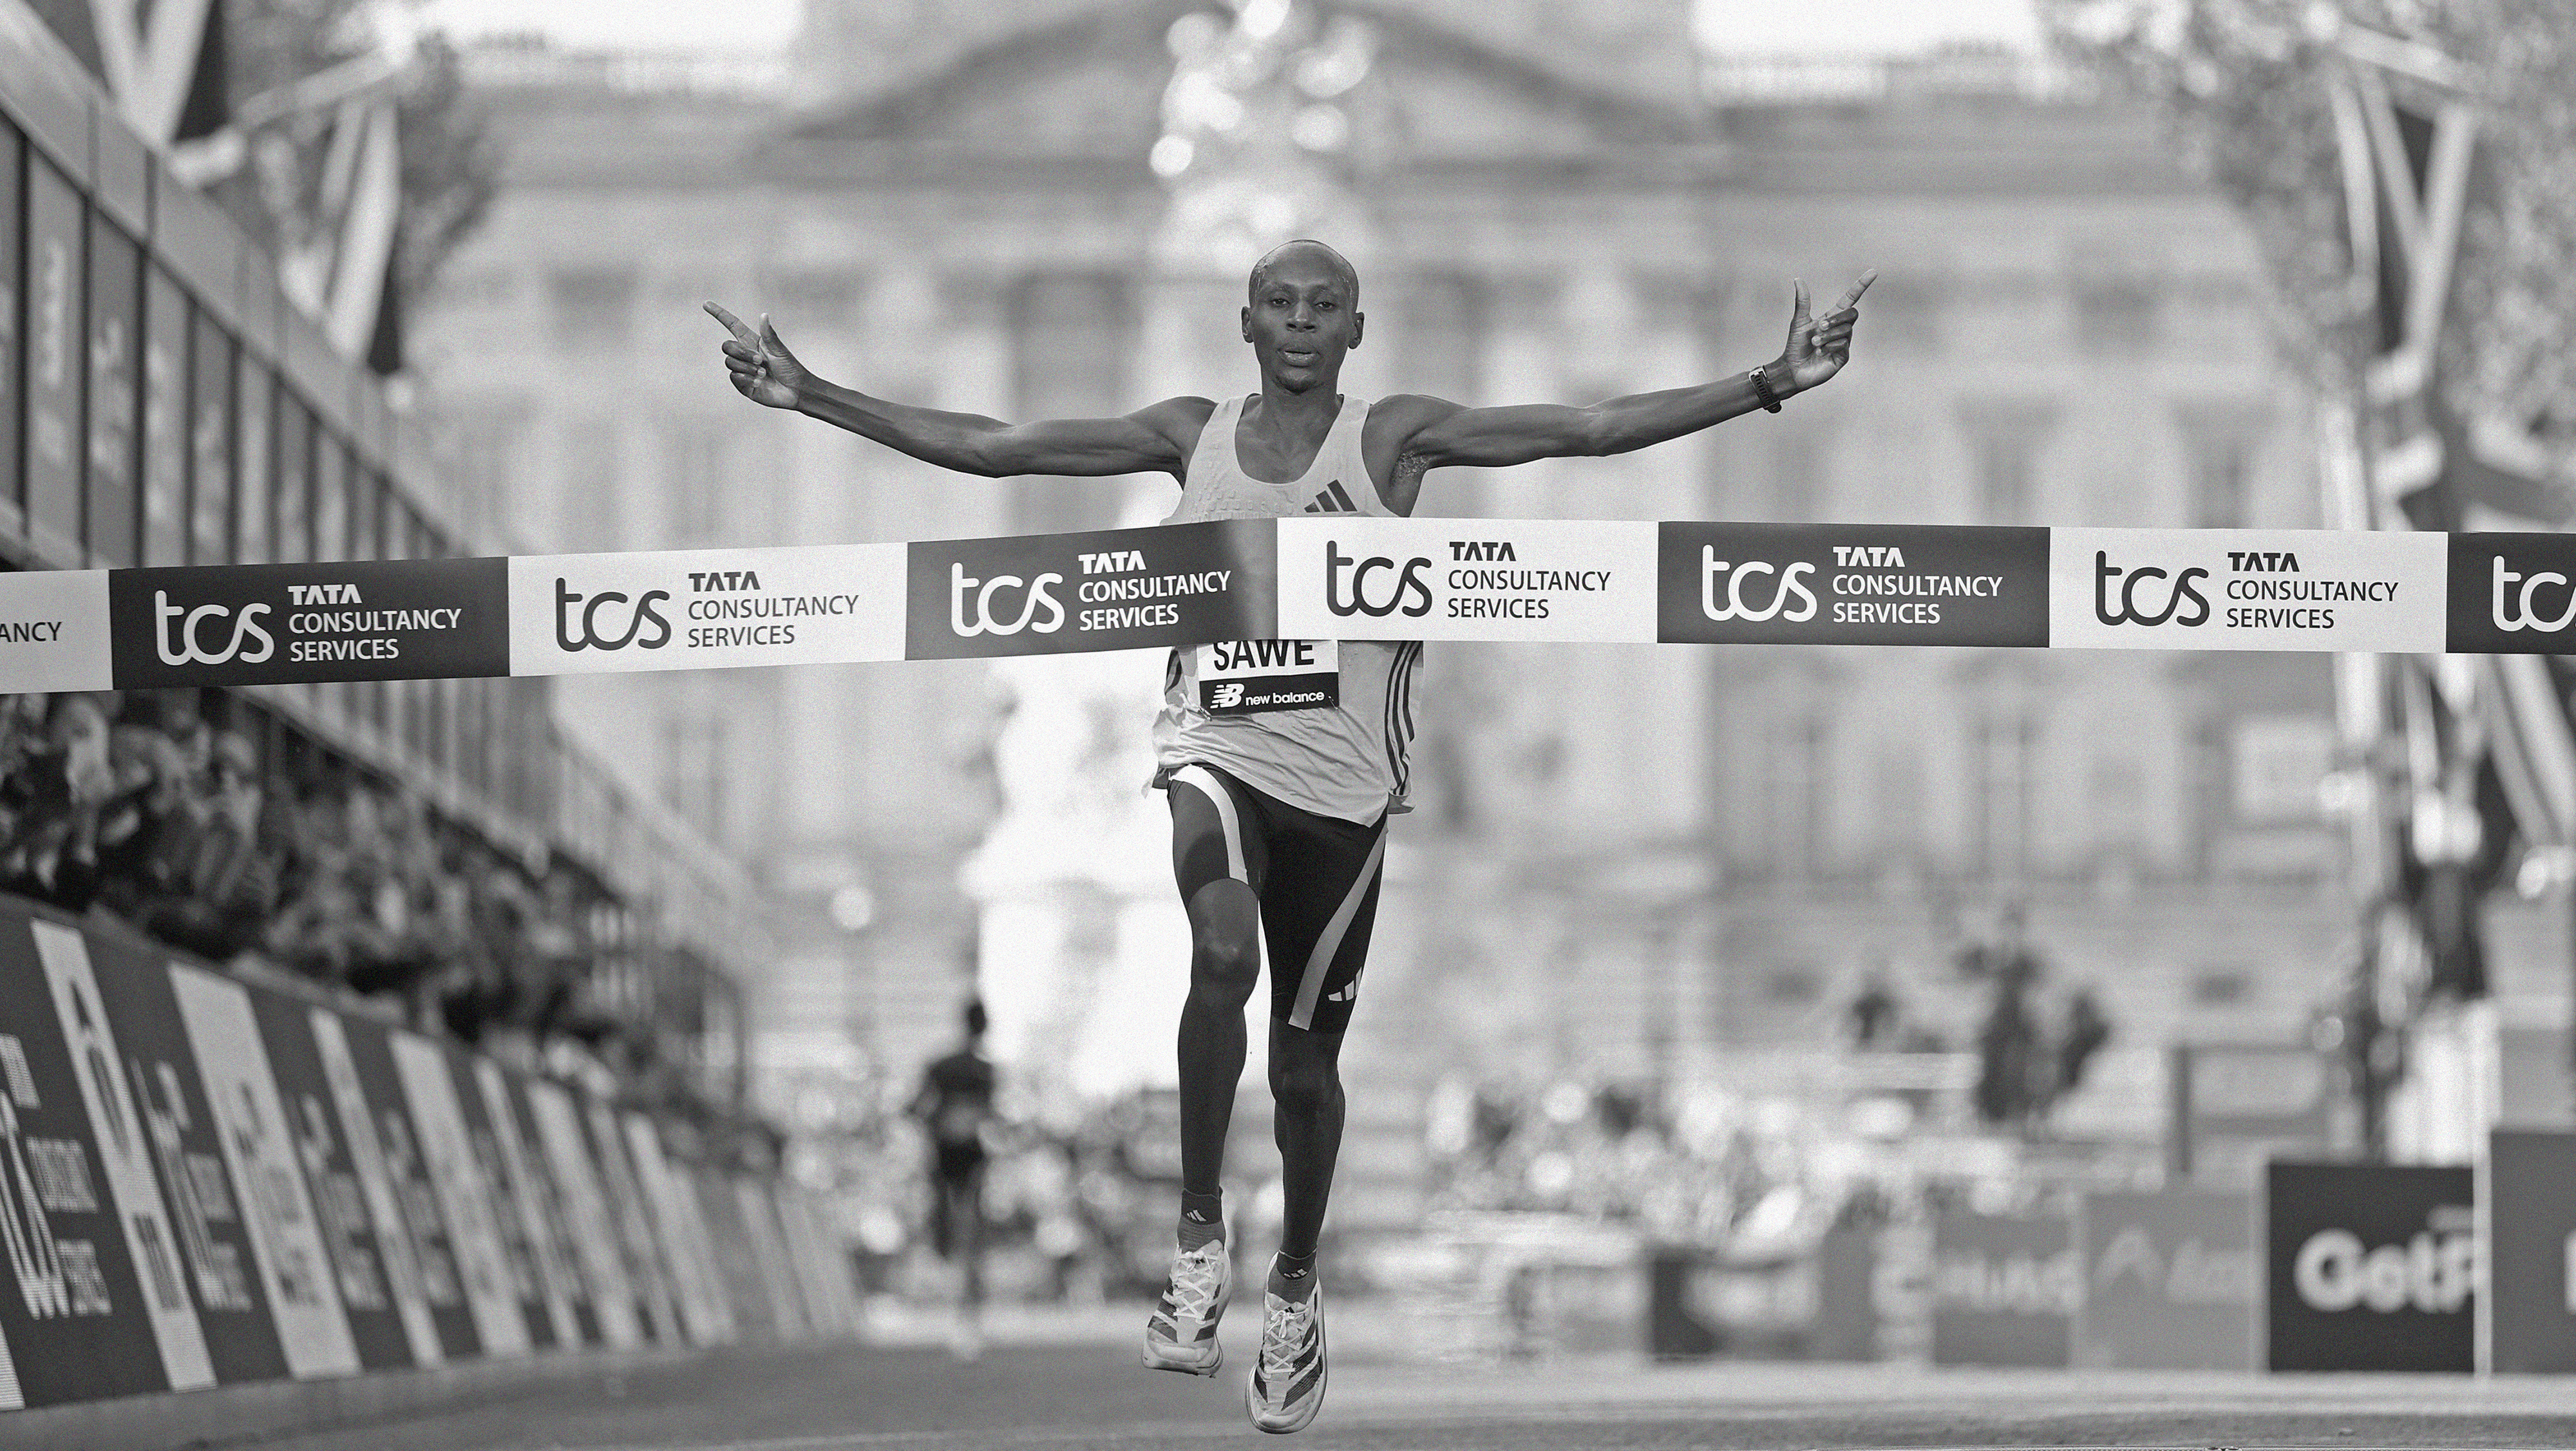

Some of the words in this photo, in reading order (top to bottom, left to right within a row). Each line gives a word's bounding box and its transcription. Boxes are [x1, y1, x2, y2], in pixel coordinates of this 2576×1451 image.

[1077, 550, 1147, 575] TATA
[1449, 542, 1516, 561] TATA
[1832, 546, 1906, 567] TATA
[2228, 552, 2300, 572] TATA
[688, 571, 760, 592] TATA
[1078, 570, 1231, 603] CONSULTANCY
[1327, 540, 1432, 617] tcs
[1448, 569, 1611, 591] CONSULTANCY
[1701, 544, 1818, 623] tcs
[1832, 574, 2003, 597] CONSULTANCY
[2096, 550, 2210, 627] tcs
[288, 583, 362, 605] TATA
[950, 562, 1066, 638] tcs
[2227, 580, 2398, 602] CONSULTANCY
[2493, 555, 2576, 632] tc
[556, 578, 671, 652] tcs
[688, 595, 859, 620] CONSULTANCY
[1079, 603, 1179, 632] SERVICES
[1448, 598, 1549, 619] SERVICES
[1833, 602, 1941, 625] SERVICES
[2227, 608, 2334, 629] SERVICES
[155, 590, 274, 665] tcs
[289, 608, 462, 634] CONSULTANCY
[688, 625, 795, 647] SERVICES
[290, 639, 399, 662] SERVICES
[1213, 640, 1314, 671] SAWE
[1245, 695, 1271, 706] new
[1273, 691, 1325, 704] balance
